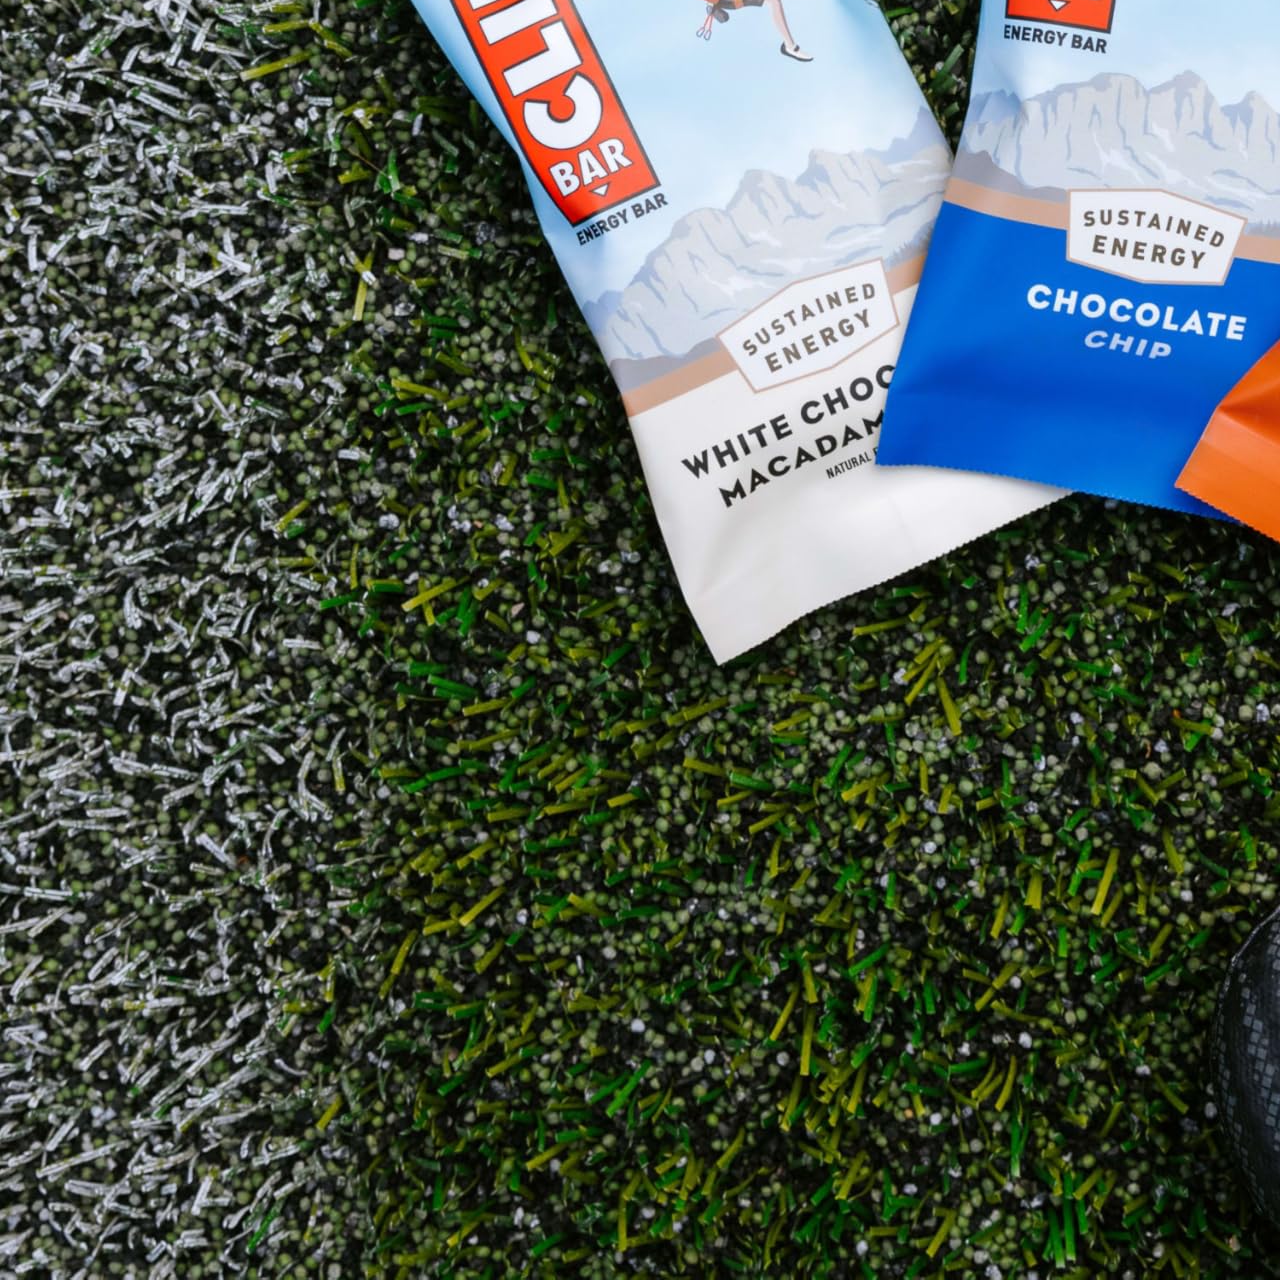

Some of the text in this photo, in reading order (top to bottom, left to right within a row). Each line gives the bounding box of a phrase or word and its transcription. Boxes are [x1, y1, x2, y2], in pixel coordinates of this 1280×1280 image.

[1003, 24, 1108, 54] ENERGY BAR
[549, 137, 634, 198] BAR
[576, 192, 669, 247] ENERGY BAR
[1083, 209, 1226, 249] SUSTAINED
[1091, 234, 1206, 270] ENERGY
[742, 282, 877, 357] SUSTAINED
[1026, 283, 1248, 341] CHOCOLATE
[764, 308, 872, 374] ENERGY
[1083, 330, 1172, 359] CHIP
[680, 413, 794, 480] WHITE
[825, 451, 872, 480] NATURAL
